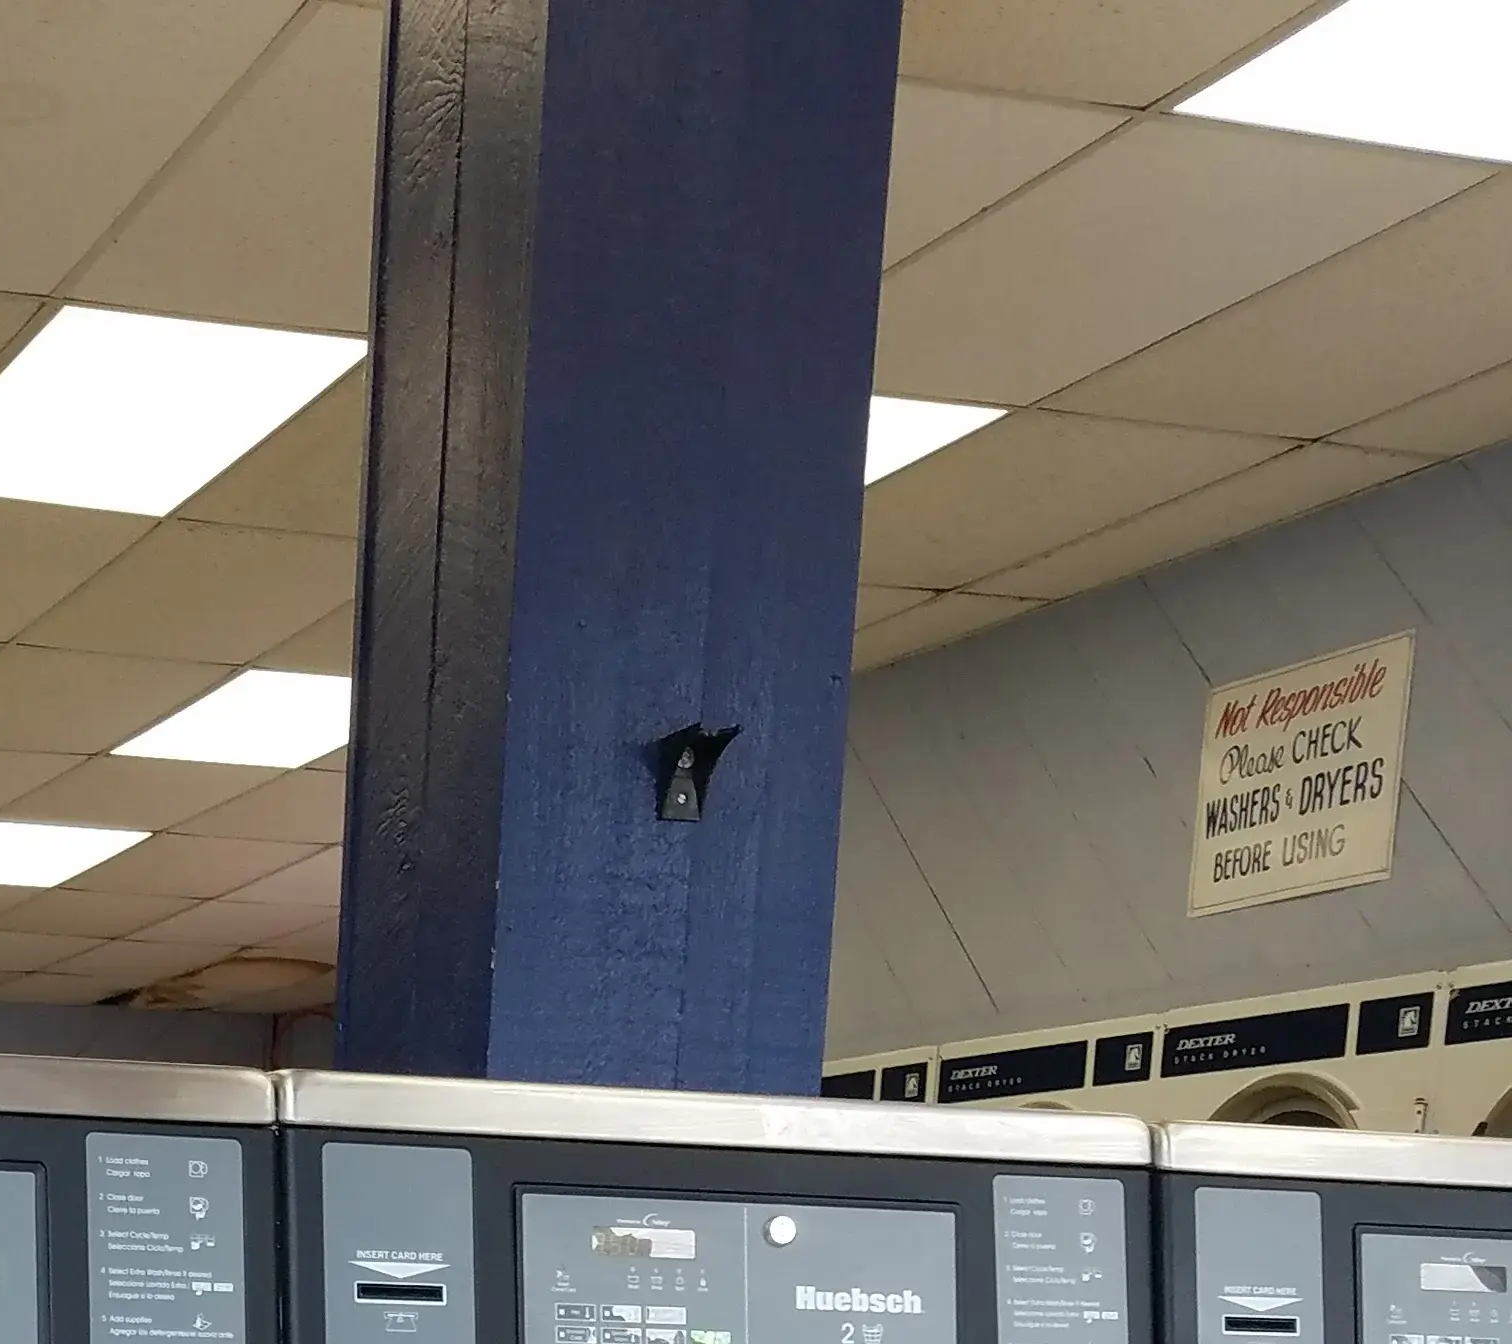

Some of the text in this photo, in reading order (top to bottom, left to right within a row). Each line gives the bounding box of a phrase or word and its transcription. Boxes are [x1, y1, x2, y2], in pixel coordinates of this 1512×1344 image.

[1215, 658, 1387, 739] Not Responsible
[1219, 716, 1363, 785] Please CHECK
[1205, 782, 1281, 839] WASHERS
[1298, 757, 1385, 816] DRYERS
[1213, 824, 1345, 883] BEFORE USING
[1176, 1033, 1236, 1051] DEXTER
[950, 1065, 998, 1081] DEXTER
[356, 1250, 444, 1261] INSERT CARD HERE
[795, 1285, 925, 1314] Huebsch
[841, 1322, 855, 1344] 2
